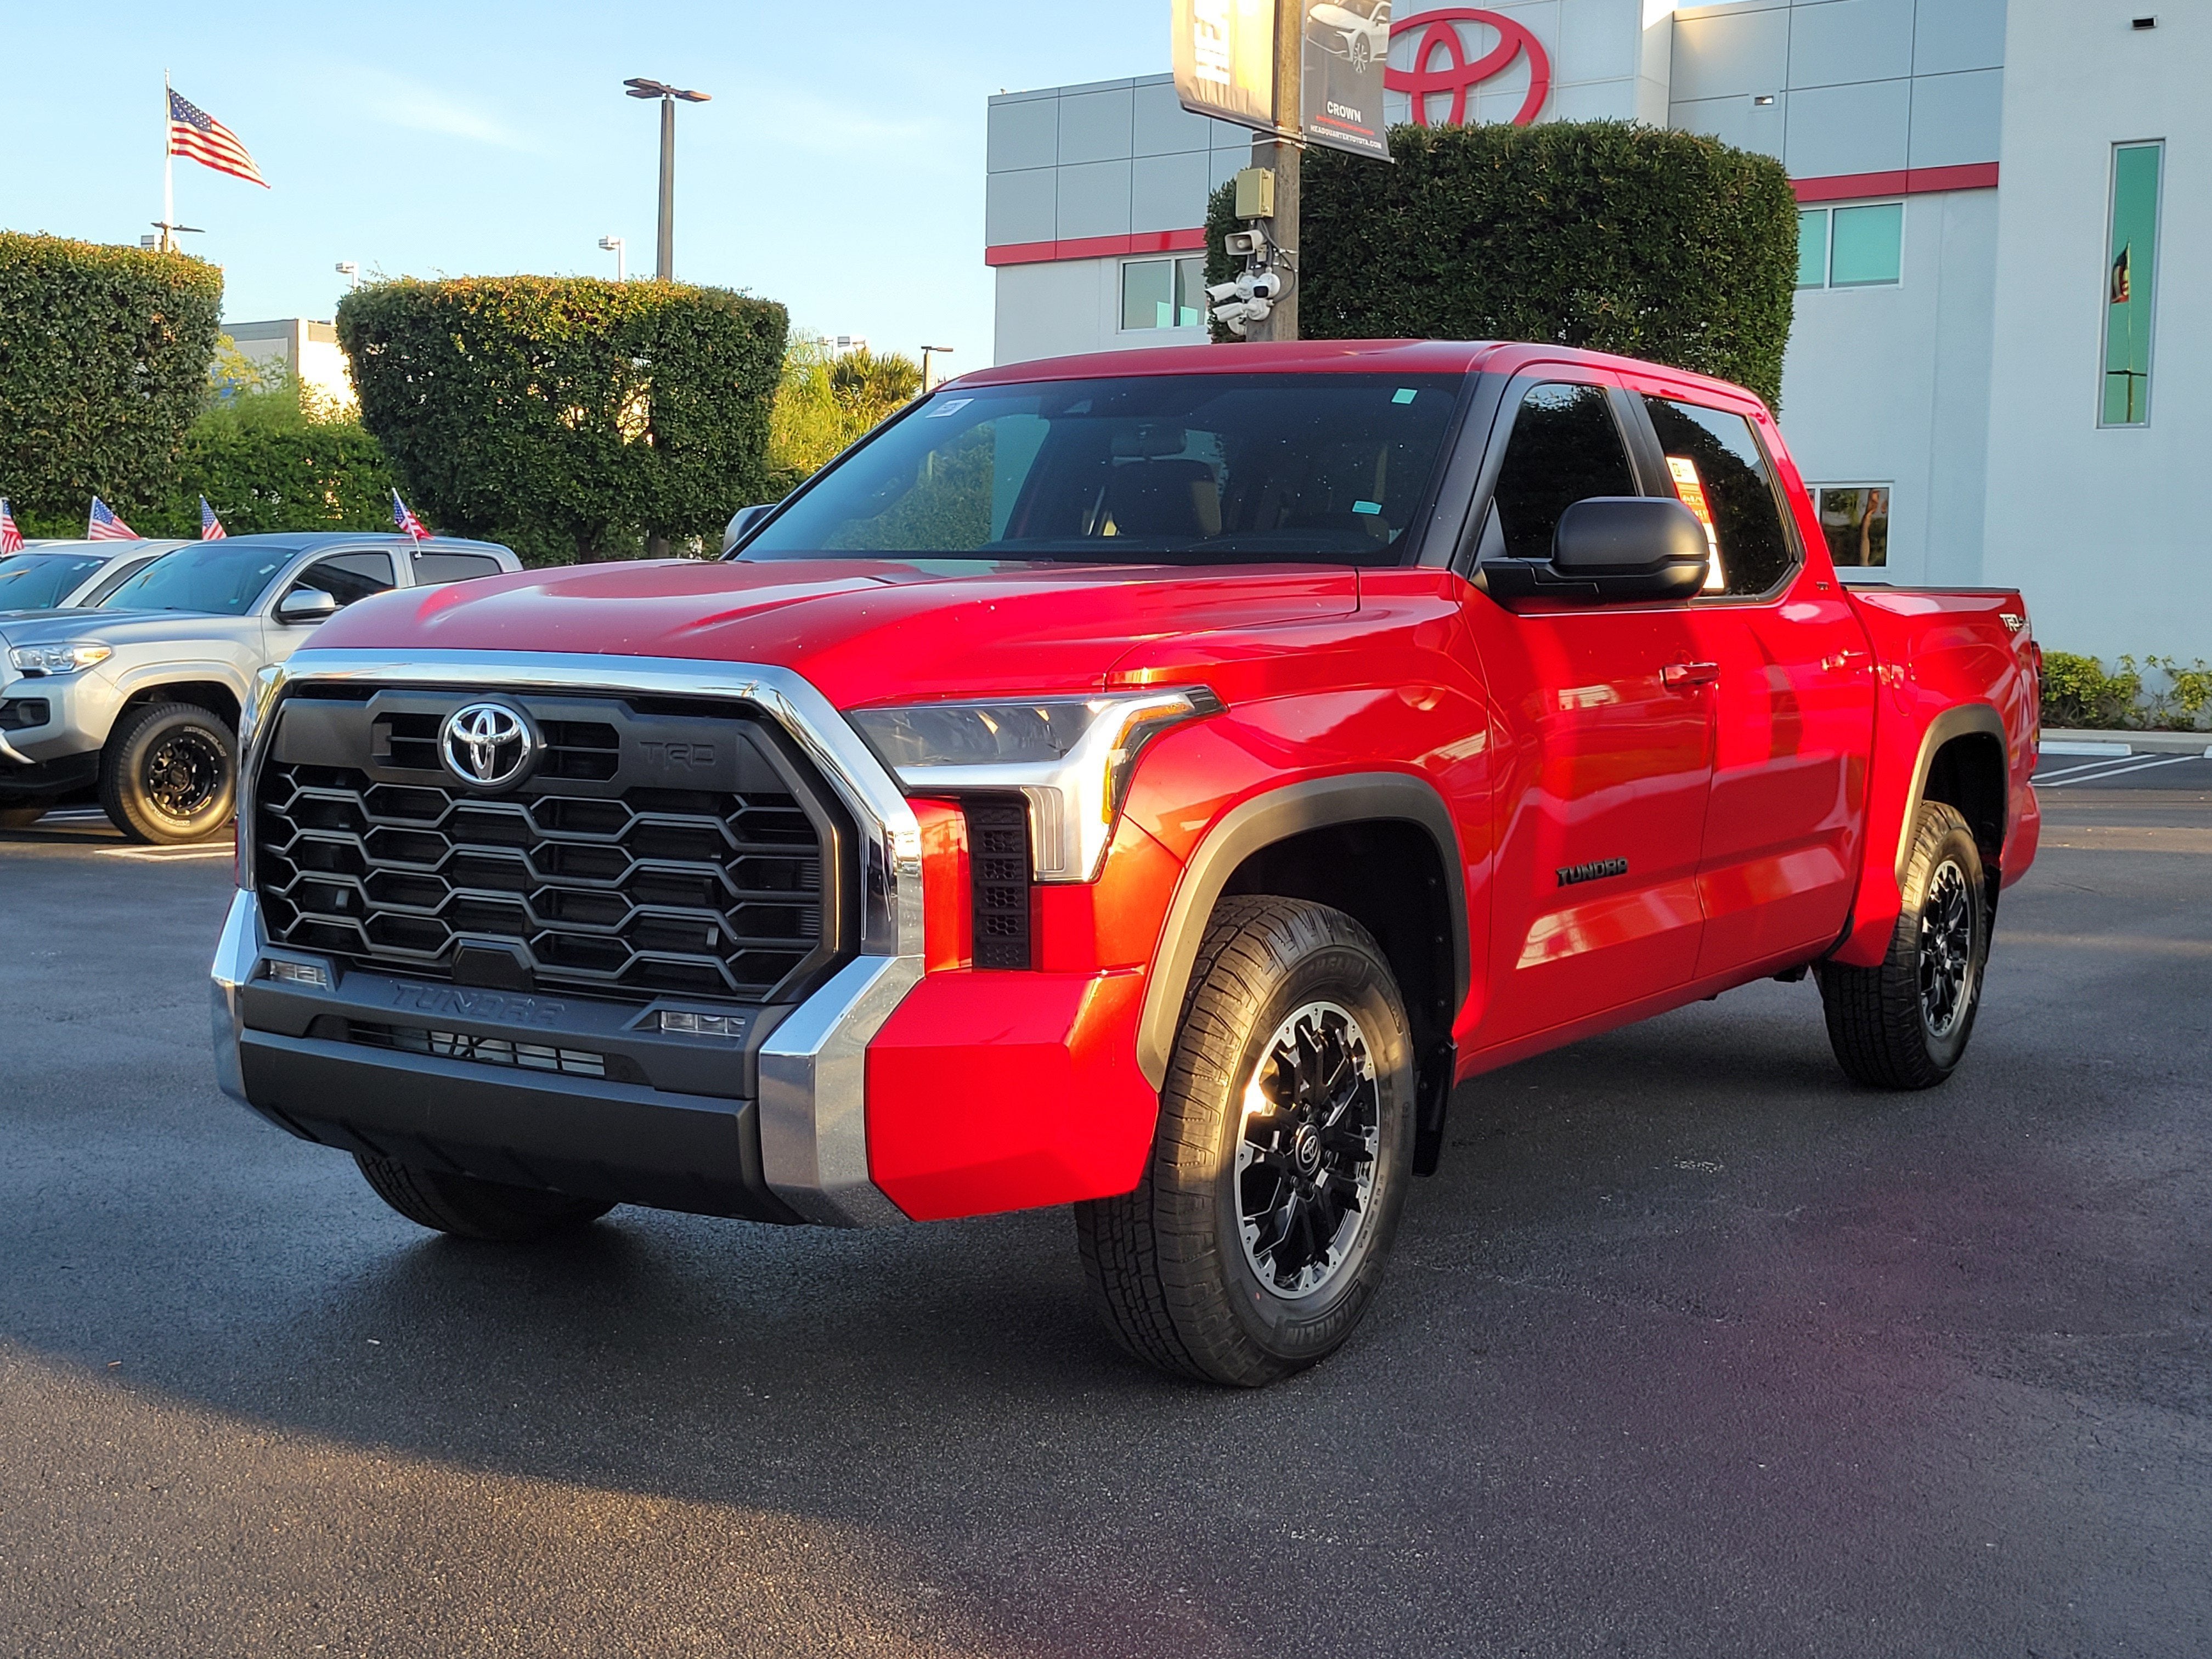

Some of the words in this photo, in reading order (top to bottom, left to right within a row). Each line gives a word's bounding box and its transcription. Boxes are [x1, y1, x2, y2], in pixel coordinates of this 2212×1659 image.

[1327, 101, 1362, 123] CROWN
[640, 741, 715, 771] TRD
[1556, 856, 1628, 888] TUNDRA
